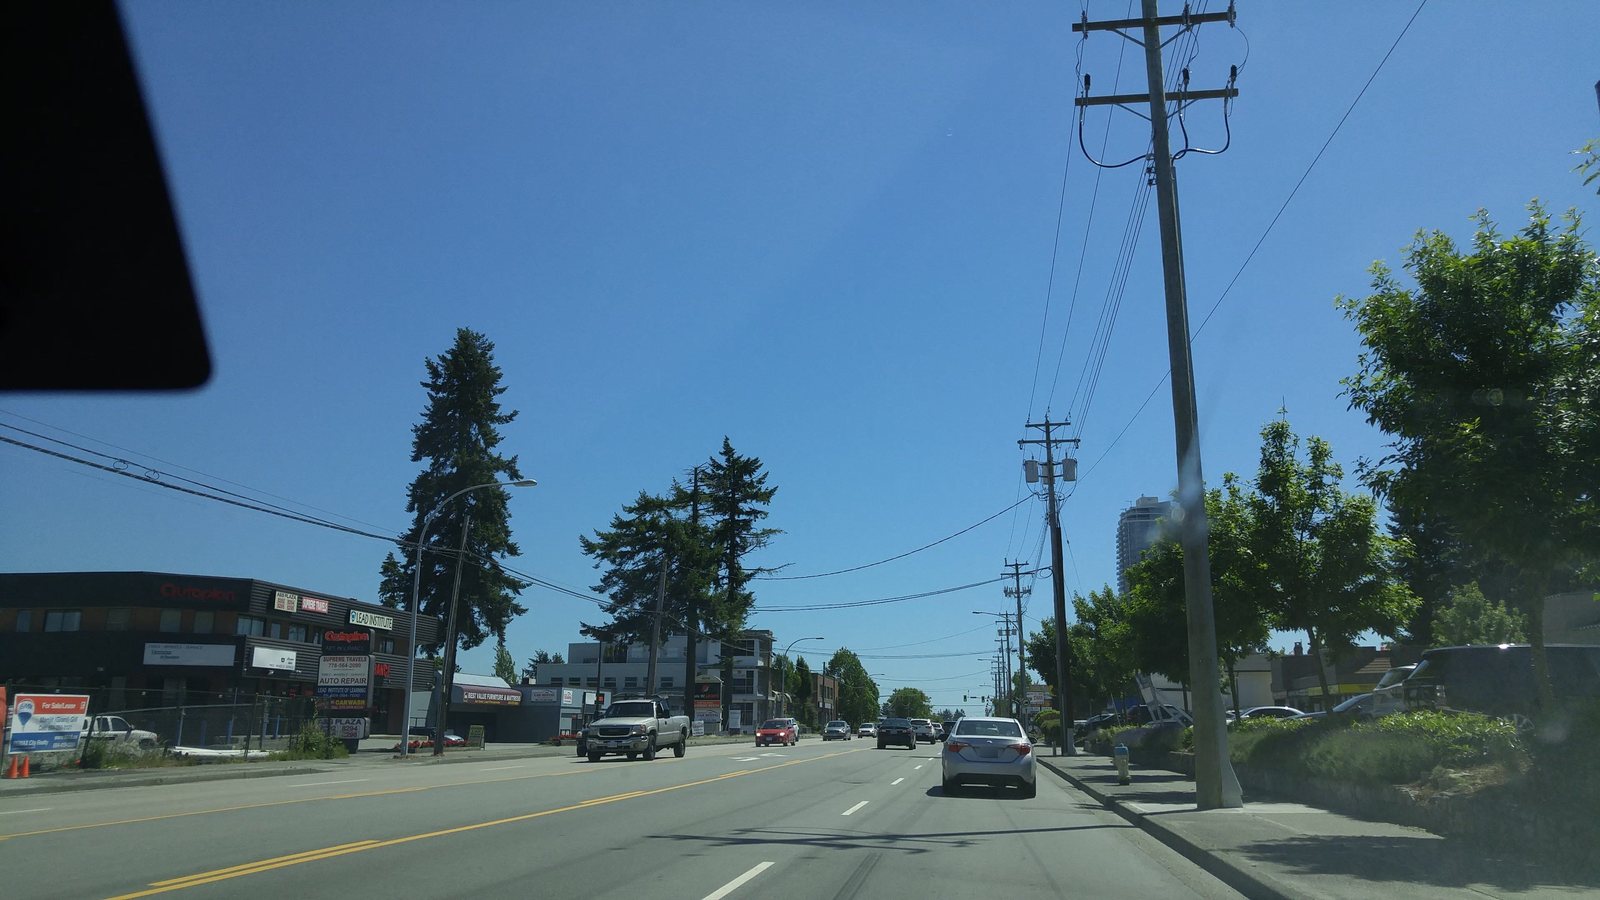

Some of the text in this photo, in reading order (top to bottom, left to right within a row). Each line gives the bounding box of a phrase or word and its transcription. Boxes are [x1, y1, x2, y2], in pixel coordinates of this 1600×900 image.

[356, 611, 393, 629] LEAD INSTITUTE
[319, 677, 367, 685] AUTO REPAIR
